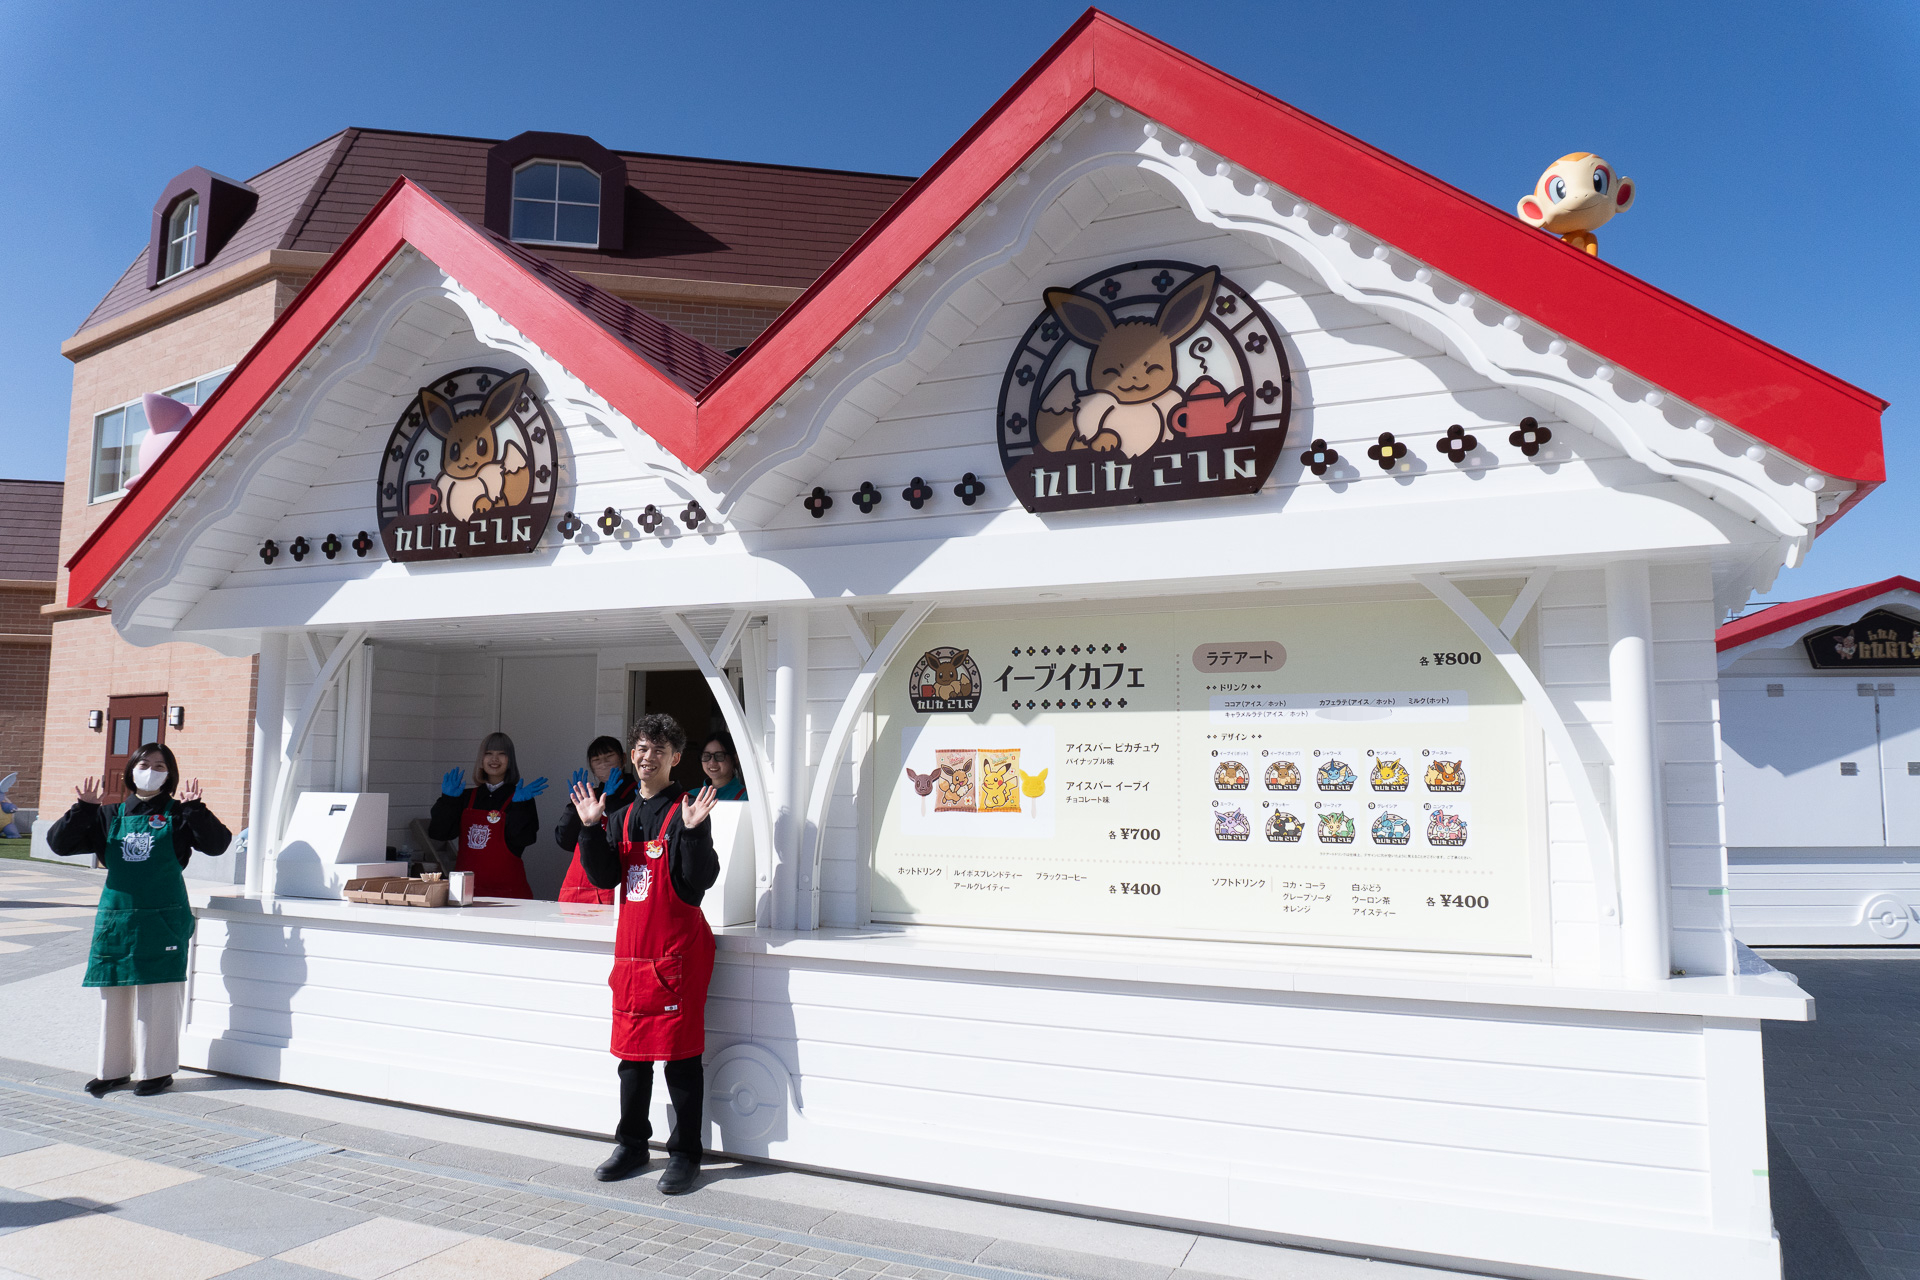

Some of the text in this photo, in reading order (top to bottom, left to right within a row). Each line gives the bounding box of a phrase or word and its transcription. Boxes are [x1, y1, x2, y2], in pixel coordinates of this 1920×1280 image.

[1207, 650, 1273, 666] ラテアート
[1419, 652, 1481, 667] 各 ¥800
[994, 663, 1144, 692] イーブイカフェ
[1220, 683, 1248, 692] ドリンク
[1221, 733, 1248, 741] デザイン
[1066, 743, 1159, 752] アイスバー ピカチュウ
[1065, 757, 1115, 766] パイナップル味
[1066, 781, 1149, 791] アイスバー イーブイ
[1065, 795, 1111, 804] チョコレート味
[1108, 828, 1160, 840] 各 ¥700
[898, 867, 941, 876] ホットドリンク
[954, 870, 1022, 878] ルイボスブレンドティー
[1036, 873, 1087, 881] ブラックコーヒー
[953, 882, 1010, 892] アールグレイティー
[1212, 879, 1265, 888] ソフトドリンク
[1351, 883, 1382, 893] 白ぶどう
[1108, 883, 1161, 895] 各 ¥400
[1283, 893, 1331, 902] グレープソーダ
[1351, 895, 1391, 905] ウーロン茶
[1425, 894, 1489, 908] 各 ¥400
[1282, 904, 1311, 914] オレンジ
[1352, 908, 1397, 917] アイスティー
